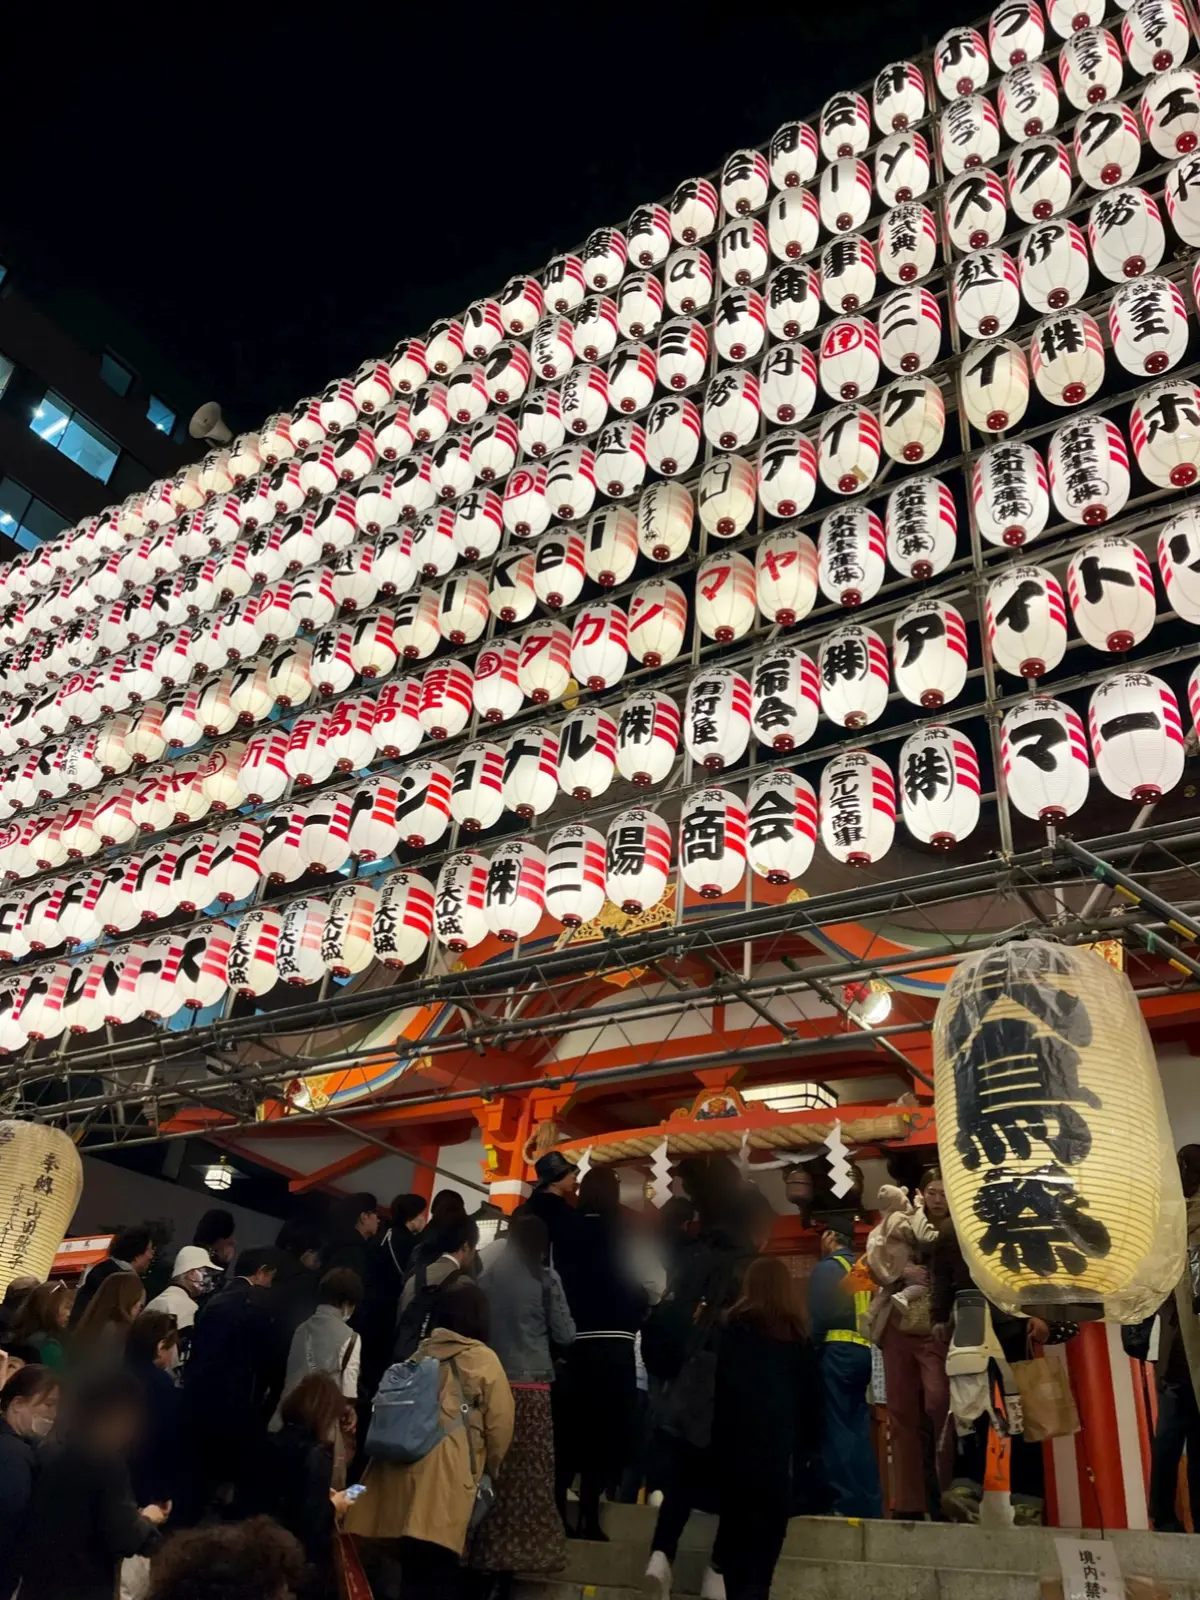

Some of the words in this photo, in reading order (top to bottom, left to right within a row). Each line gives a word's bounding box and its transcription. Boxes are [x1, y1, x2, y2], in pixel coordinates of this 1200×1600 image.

[950, 177, 992, 229] ス
[721, 227, 750, 259] m
[1024, 226, 1065, 266] 伊
[957, 253, 1003, 302] 越
[659, 325, 696, 359] ミ
[608, 348, 640, 386] ナ
[966, 345, 1010, 388] イ
[649, 402, 680, 435] 伊
[882, 388, 927, 428] ケ
[1144, 393, 1200, 444] ホ
[822, 413, 859, 458] イ
[761, 438, 800, 482] テ
[761, 550, 799, 582] ヤ
[1079, 556, 1136, 605] ト
[995, 580, 1046, 633] イ
[571, 613, 606, 650] カ
[896, 613, 946, 669] ア
[502, 738, 542, 785] ナ
[557, 719, 598, 769] ル
[1009, 717, 1068, 772] マ
[394, 776, 431, 823] シ
[750, 790, 798, 848] 会
[682, 806, 726, 867] 商
